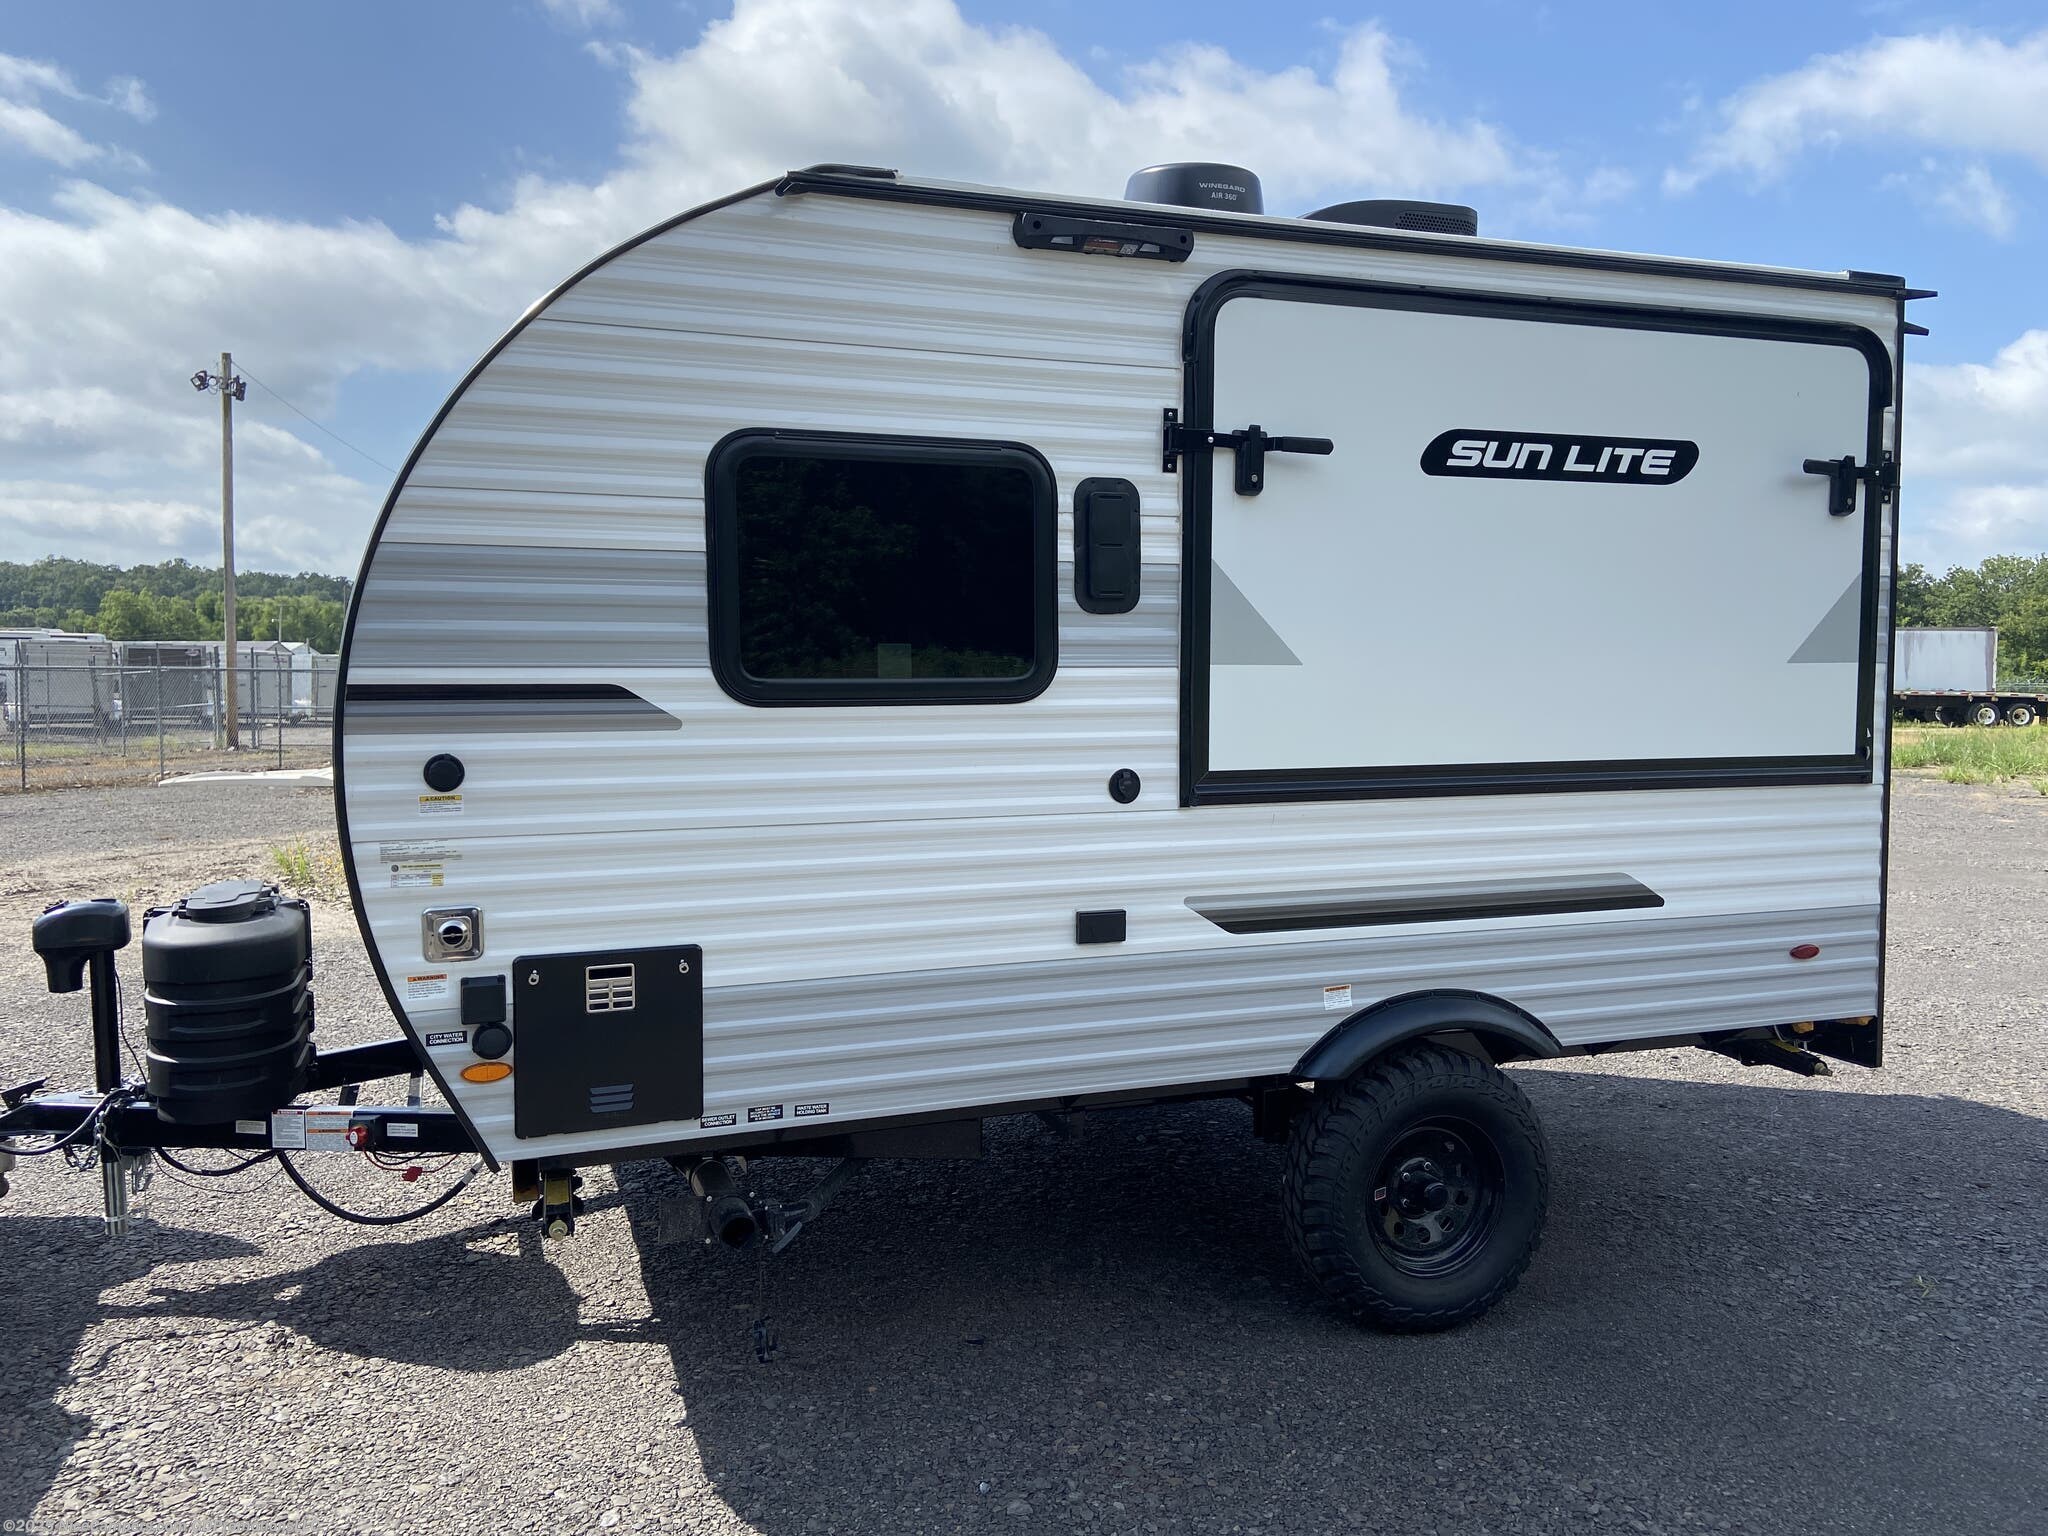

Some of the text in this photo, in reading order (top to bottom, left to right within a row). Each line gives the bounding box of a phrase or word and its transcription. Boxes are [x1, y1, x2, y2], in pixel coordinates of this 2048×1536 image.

[1199, 182, 1246, 192] WINEGARD
[1446, 439, 1677, 476] SUN LITE
[443, 1031, 463, 1039] WATER
[430, 1037, 464, 1045] CONNECTION
